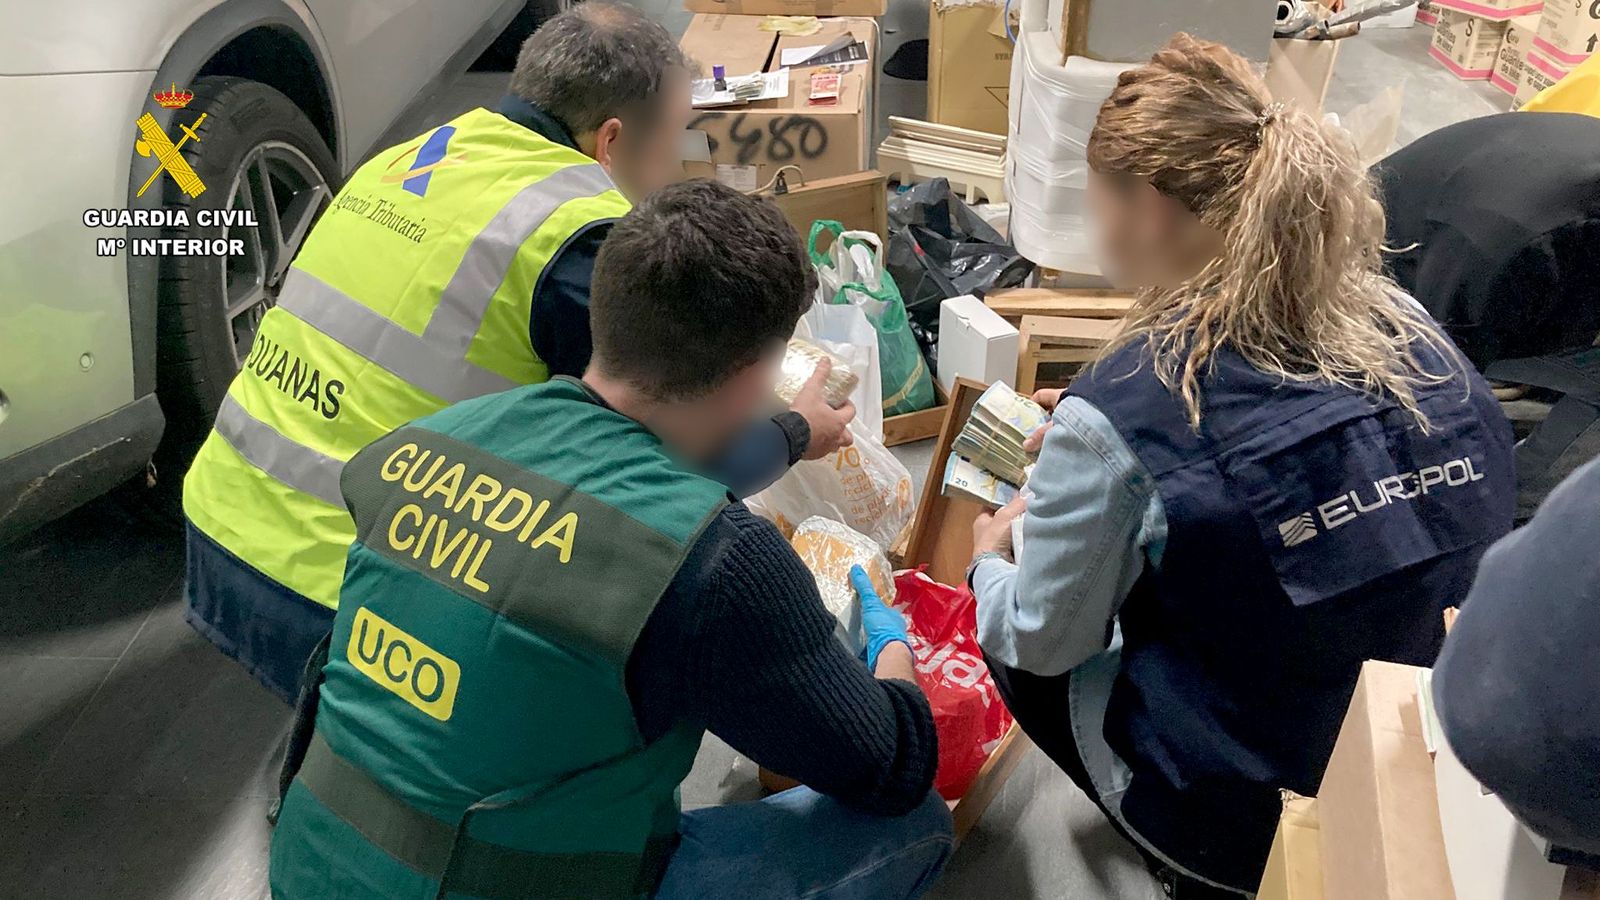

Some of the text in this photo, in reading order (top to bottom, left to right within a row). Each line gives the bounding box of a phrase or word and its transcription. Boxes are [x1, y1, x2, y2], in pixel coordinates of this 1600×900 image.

[367, 198, 428, 243] Tributaria
[248, 332, 345, 420] DUANAS
[381, 443, 578, 564] GUARDIA
[955, 477, 968, 487] 20
[1317, 456, 1485, 530] EUROPOL
[388, 504, 493, 593] CIVIL
[357, 618, 445, 703] UCO
